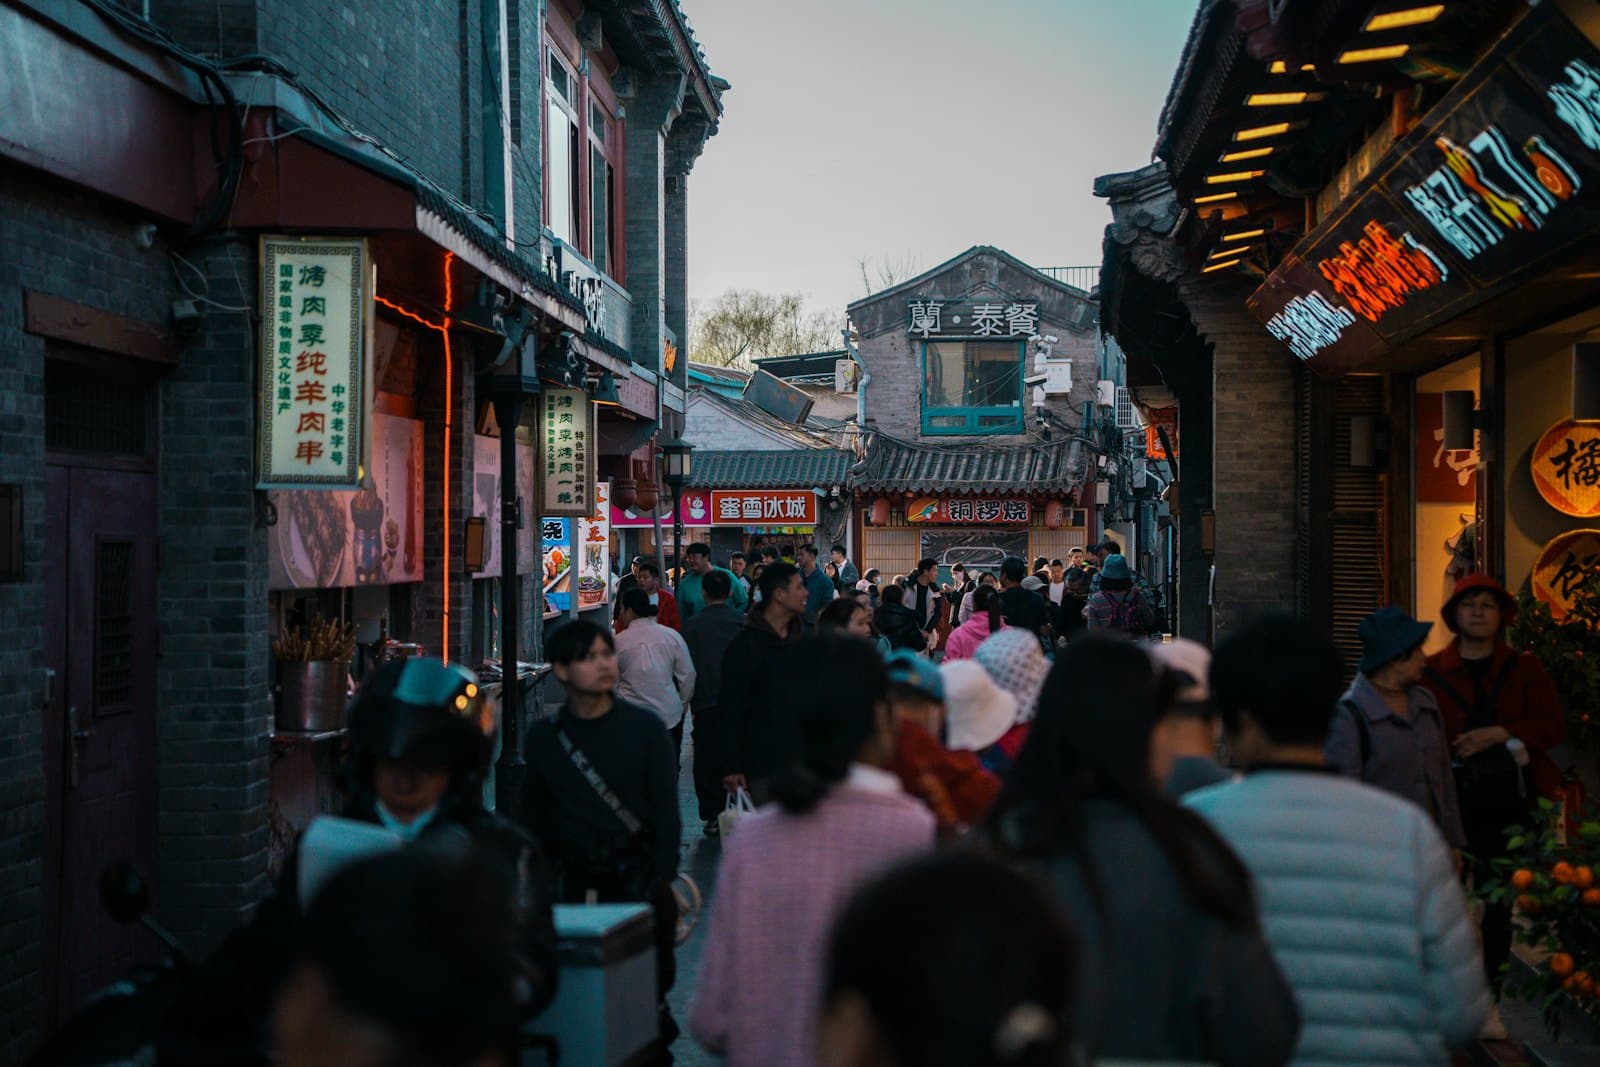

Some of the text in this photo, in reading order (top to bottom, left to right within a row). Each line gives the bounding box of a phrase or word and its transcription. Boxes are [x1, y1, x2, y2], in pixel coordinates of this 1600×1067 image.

[278, 264, 294, 416] 国家级非物质文化遗产
[294, 264, 328, 465] 烤肉季纯羊肉串
[330, 383, 346, 467] 中华老字号
[547, 395, 556, 478] 国家级非物质文化遗产
[719, 496, 807, 520] 蜜雪冰城
[948, 500, 1029, 521] 铜锣烧
